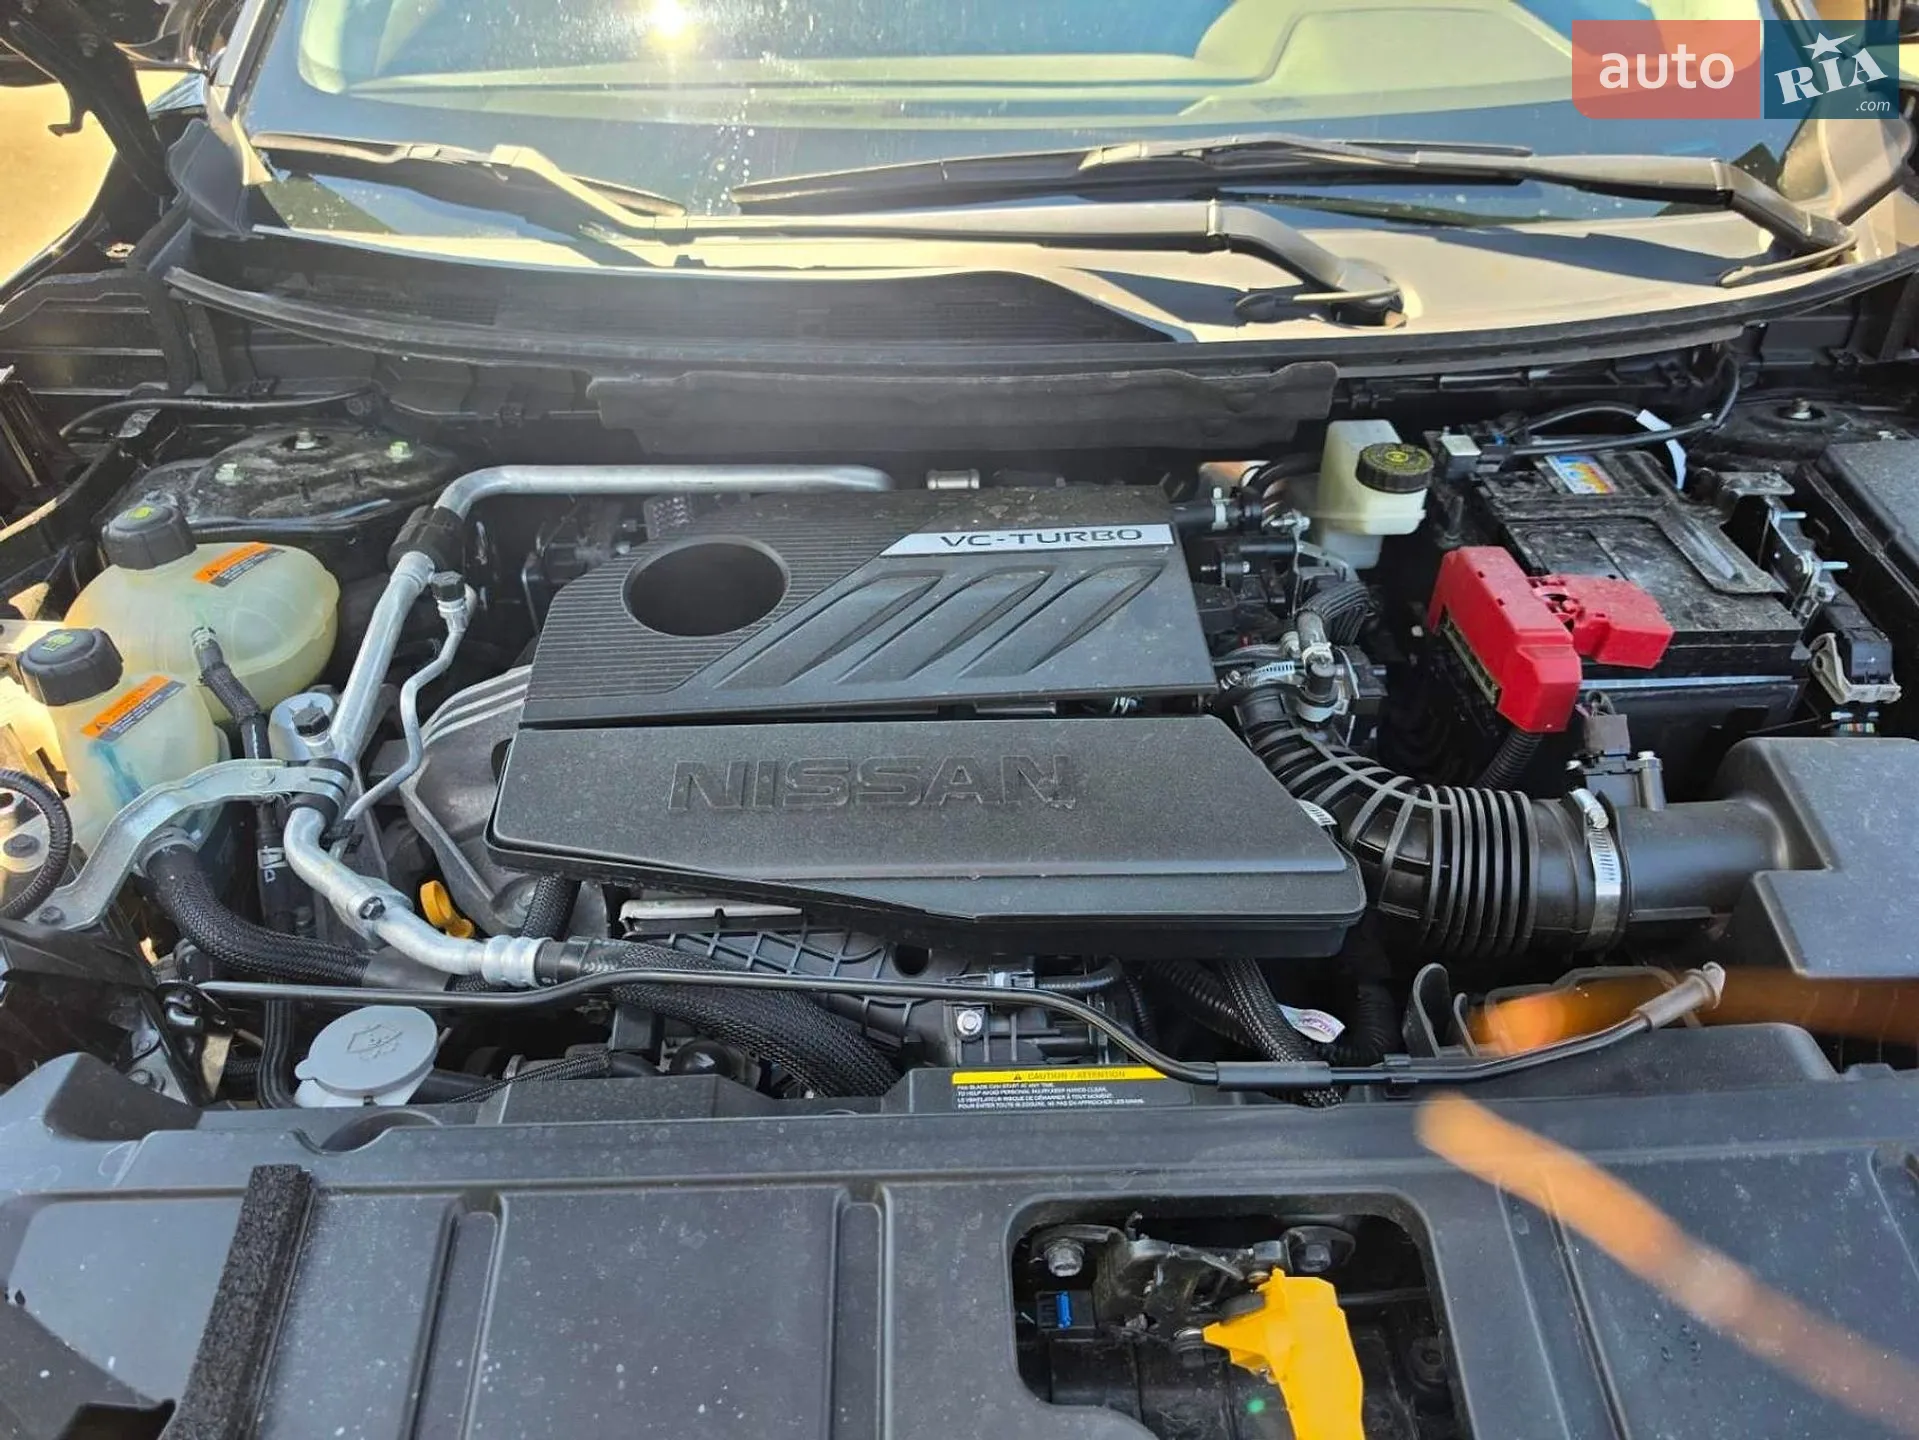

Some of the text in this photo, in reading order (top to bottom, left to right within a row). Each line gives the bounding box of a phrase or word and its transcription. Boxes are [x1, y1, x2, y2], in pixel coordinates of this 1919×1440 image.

[940, 529, 1142, 547] VC-TURBO
[667, 755, 1076, 810] NISSAN
[1028, 1071, 1067, 1080] CAUTION
[1076, 1070, 1125, 1079] ATTENTION
